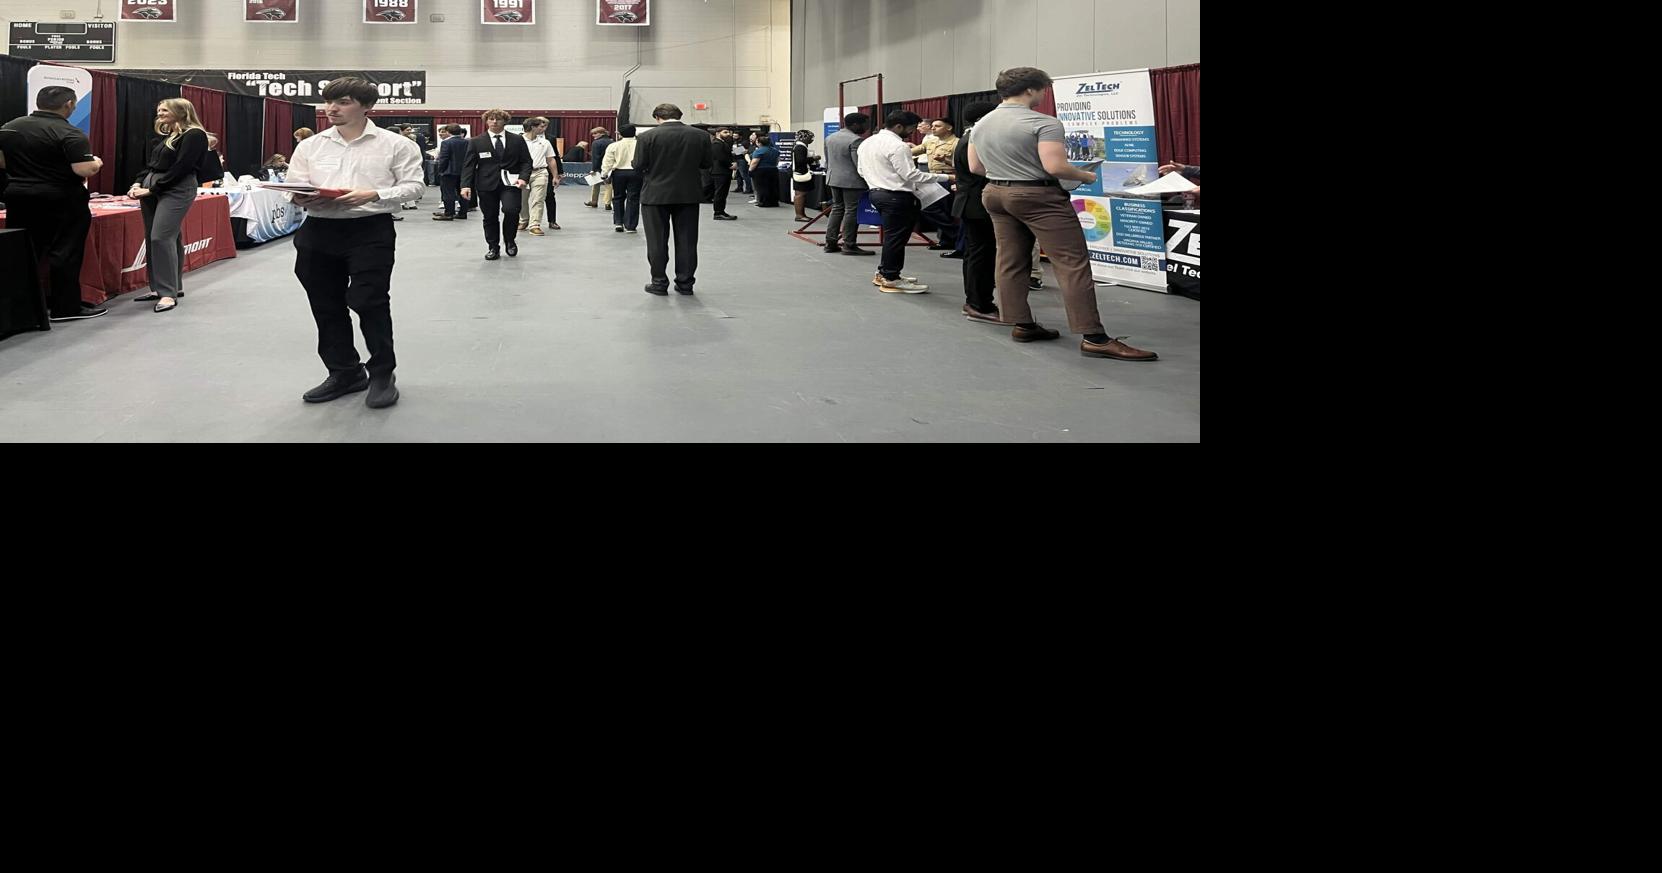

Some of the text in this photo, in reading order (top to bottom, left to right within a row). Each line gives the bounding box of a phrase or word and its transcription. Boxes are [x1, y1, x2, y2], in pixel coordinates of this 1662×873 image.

[374, 0, 409, 8] 1988
[494, 0, 523, 8] 1991
[227, 72, 286, 80] Florida Tech
[1056, 101, 1091, 111] PROVIDING
[1097, 110, 1137, 120] SOLUTIONS
[271, 203, 285, 224] pbs
[1167, 263, 1178, 273] el
